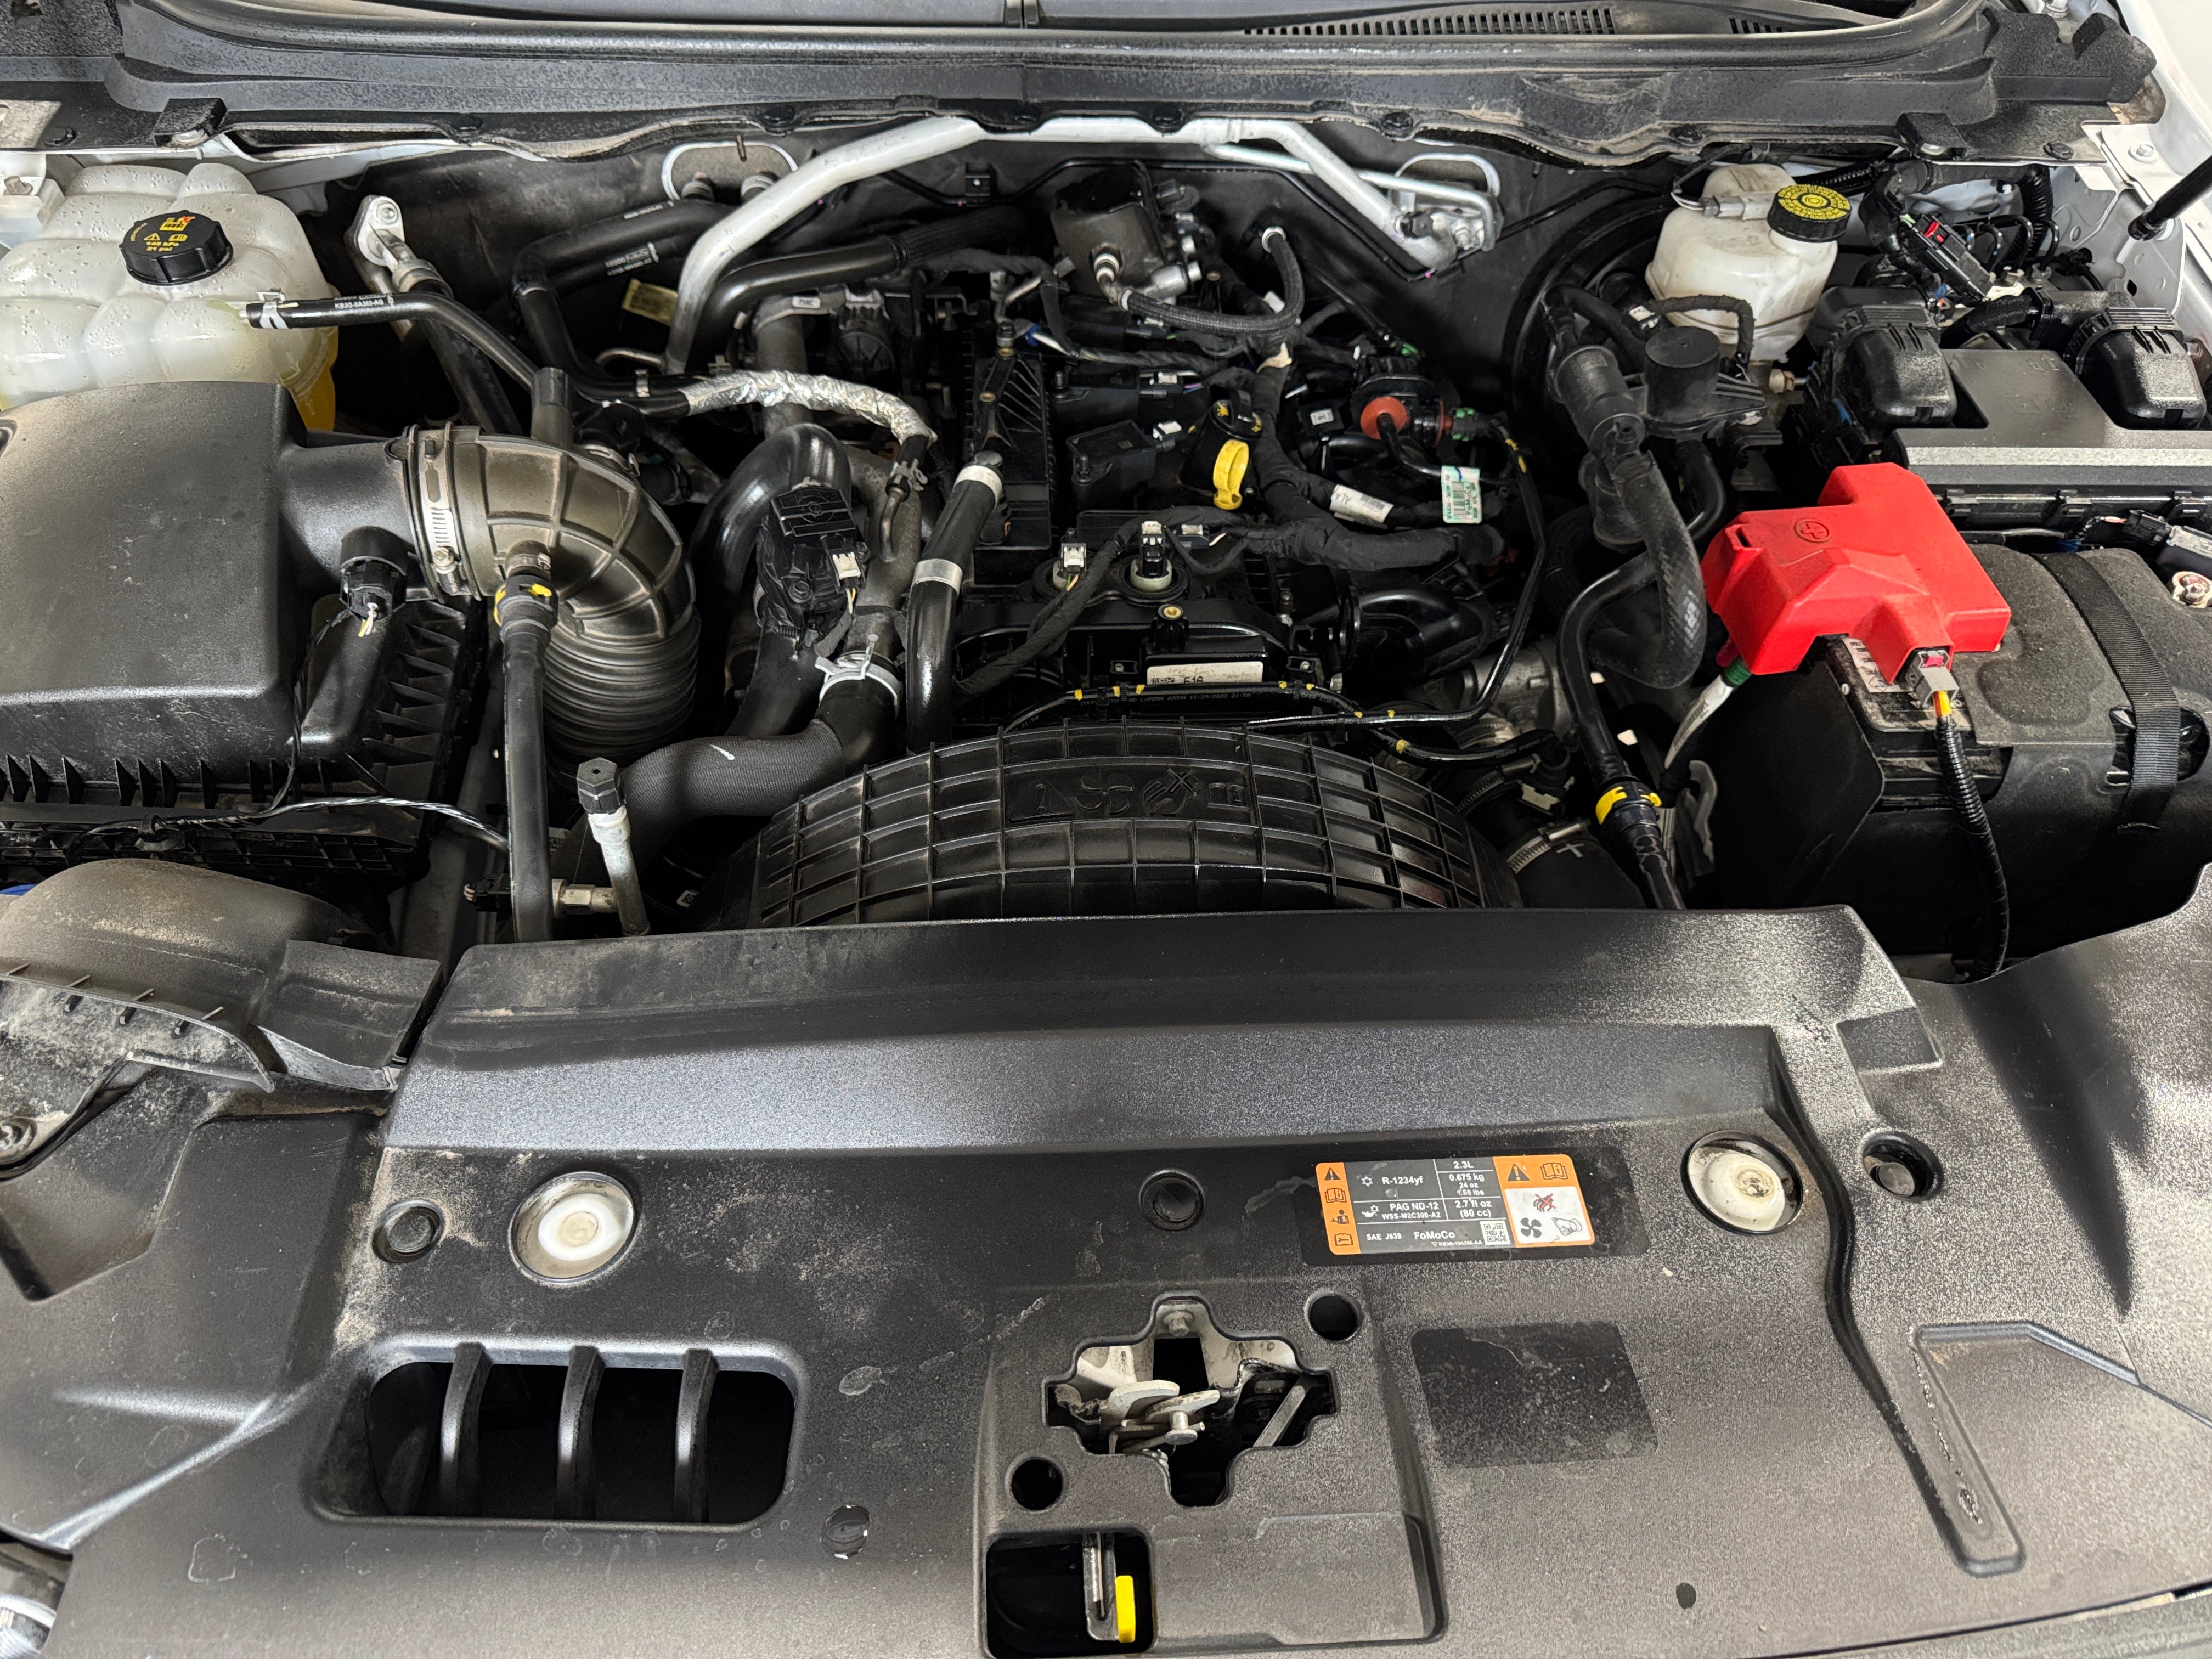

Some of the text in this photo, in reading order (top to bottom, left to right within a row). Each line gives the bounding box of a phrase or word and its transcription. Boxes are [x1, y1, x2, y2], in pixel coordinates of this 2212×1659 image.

[1382, 1175, 1423, 1186] R-1234yf
[1473, 1173, 1485, 1182] kg
[1390, 1201, 1440, 1211] PAG ND-12
[1454, 1200, 1468, 1209] 2.7
[1381, 1211, 1441, 1220] WSS-M2C300-A2
[1460, 1208, 1491, 1218] (80 cc)
[1414, 1230, 1455, 1240] FoMoCo
